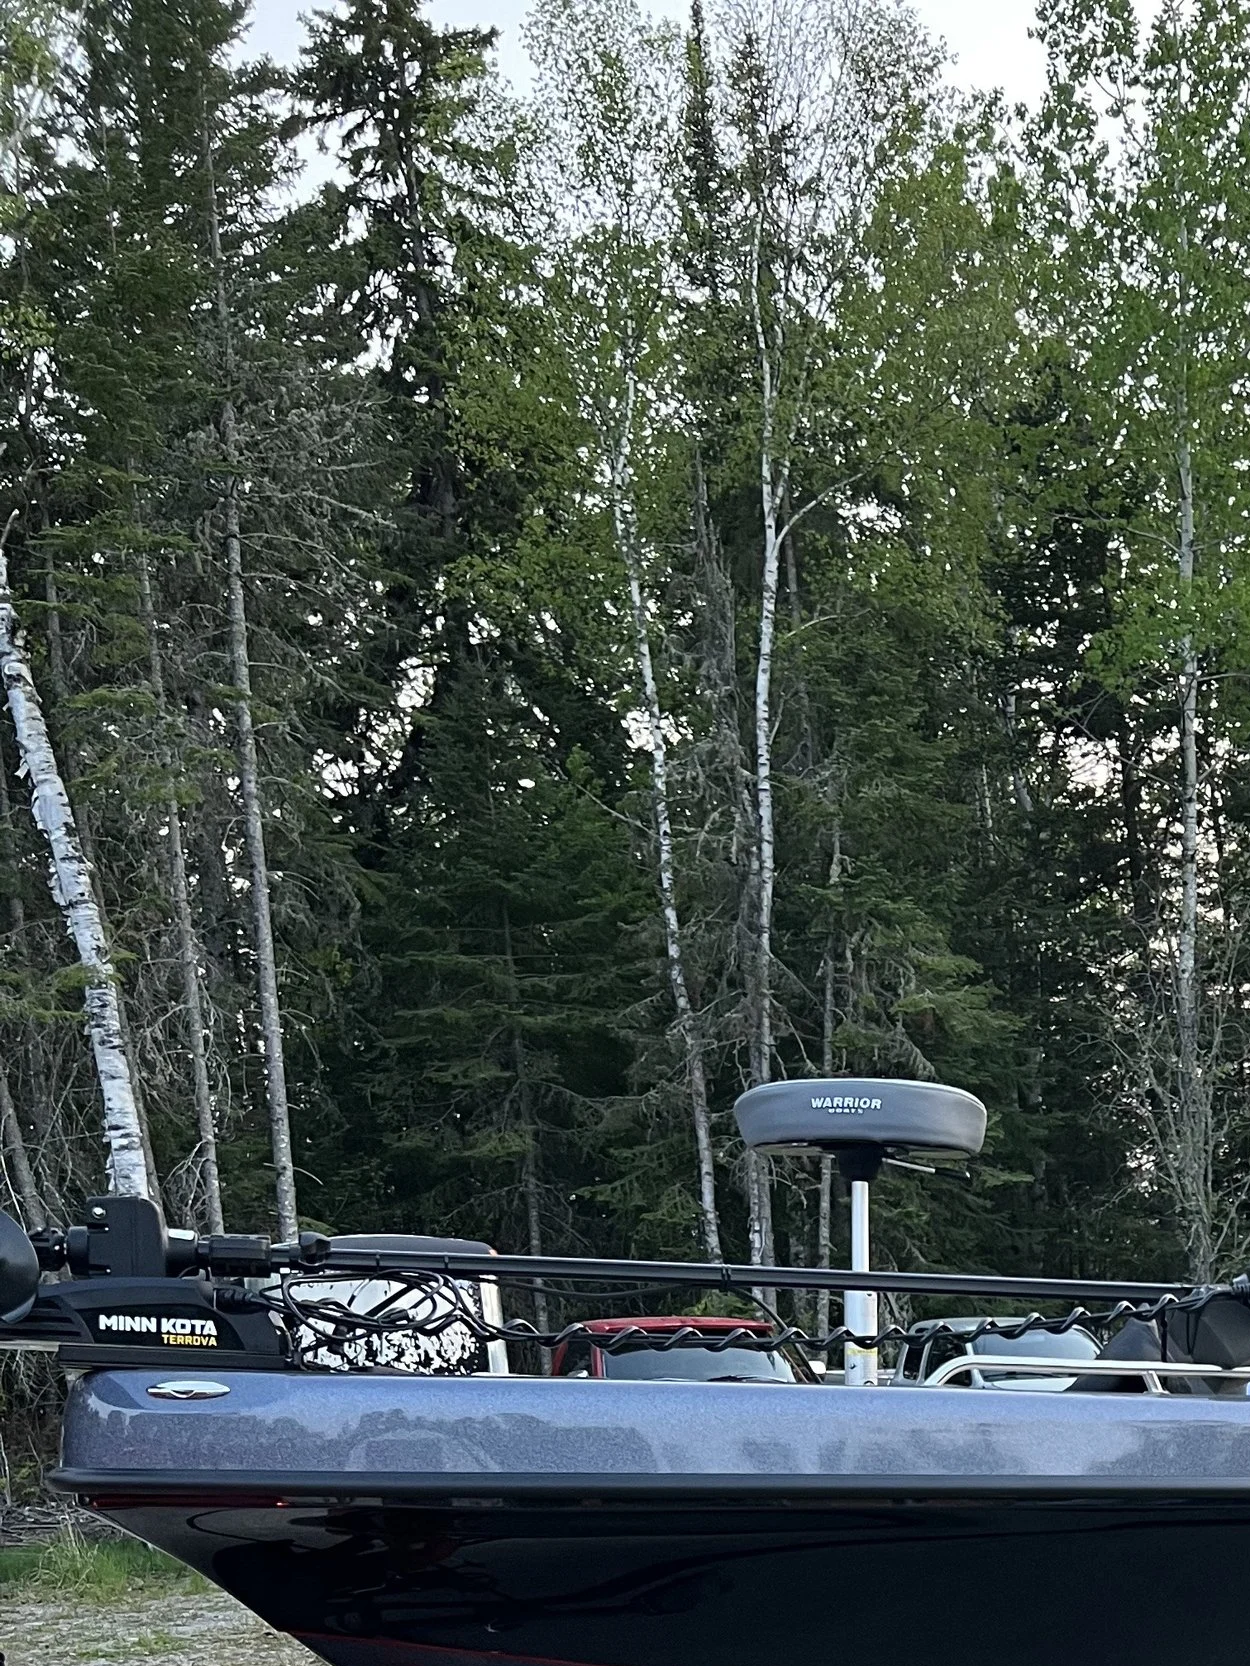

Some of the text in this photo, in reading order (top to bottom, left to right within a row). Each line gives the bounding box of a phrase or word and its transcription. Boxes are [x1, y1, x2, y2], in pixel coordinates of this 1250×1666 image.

[811, 1096, 882, 1110] WARRIOR
[98, 1314, 218, 1336] MINN KOTA
[161, 1334, 218, 1347] TERROVA
